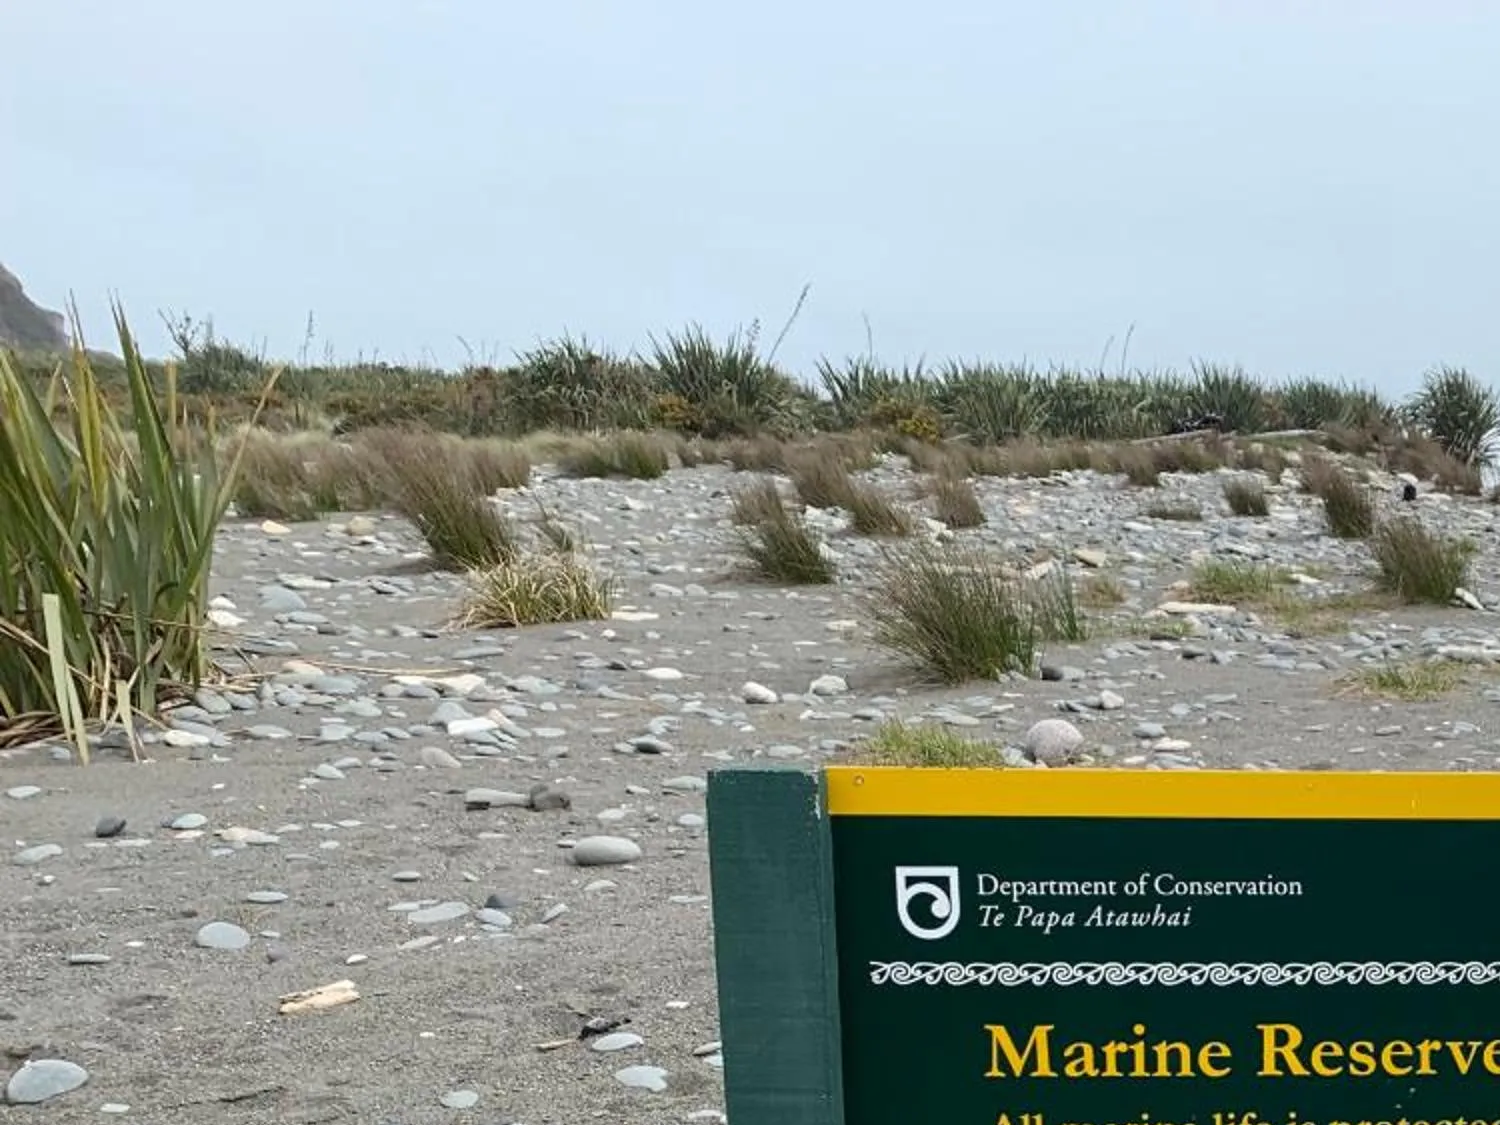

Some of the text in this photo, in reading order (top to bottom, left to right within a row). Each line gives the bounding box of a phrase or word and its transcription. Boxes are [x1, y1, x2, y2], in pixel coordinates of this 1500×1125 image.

[977, 872, 1303, 903] Department of Conservation
[978, 903, 1192, 933] Te Papa Atawhai
[983, 1023, 1232, 1078] Marine
